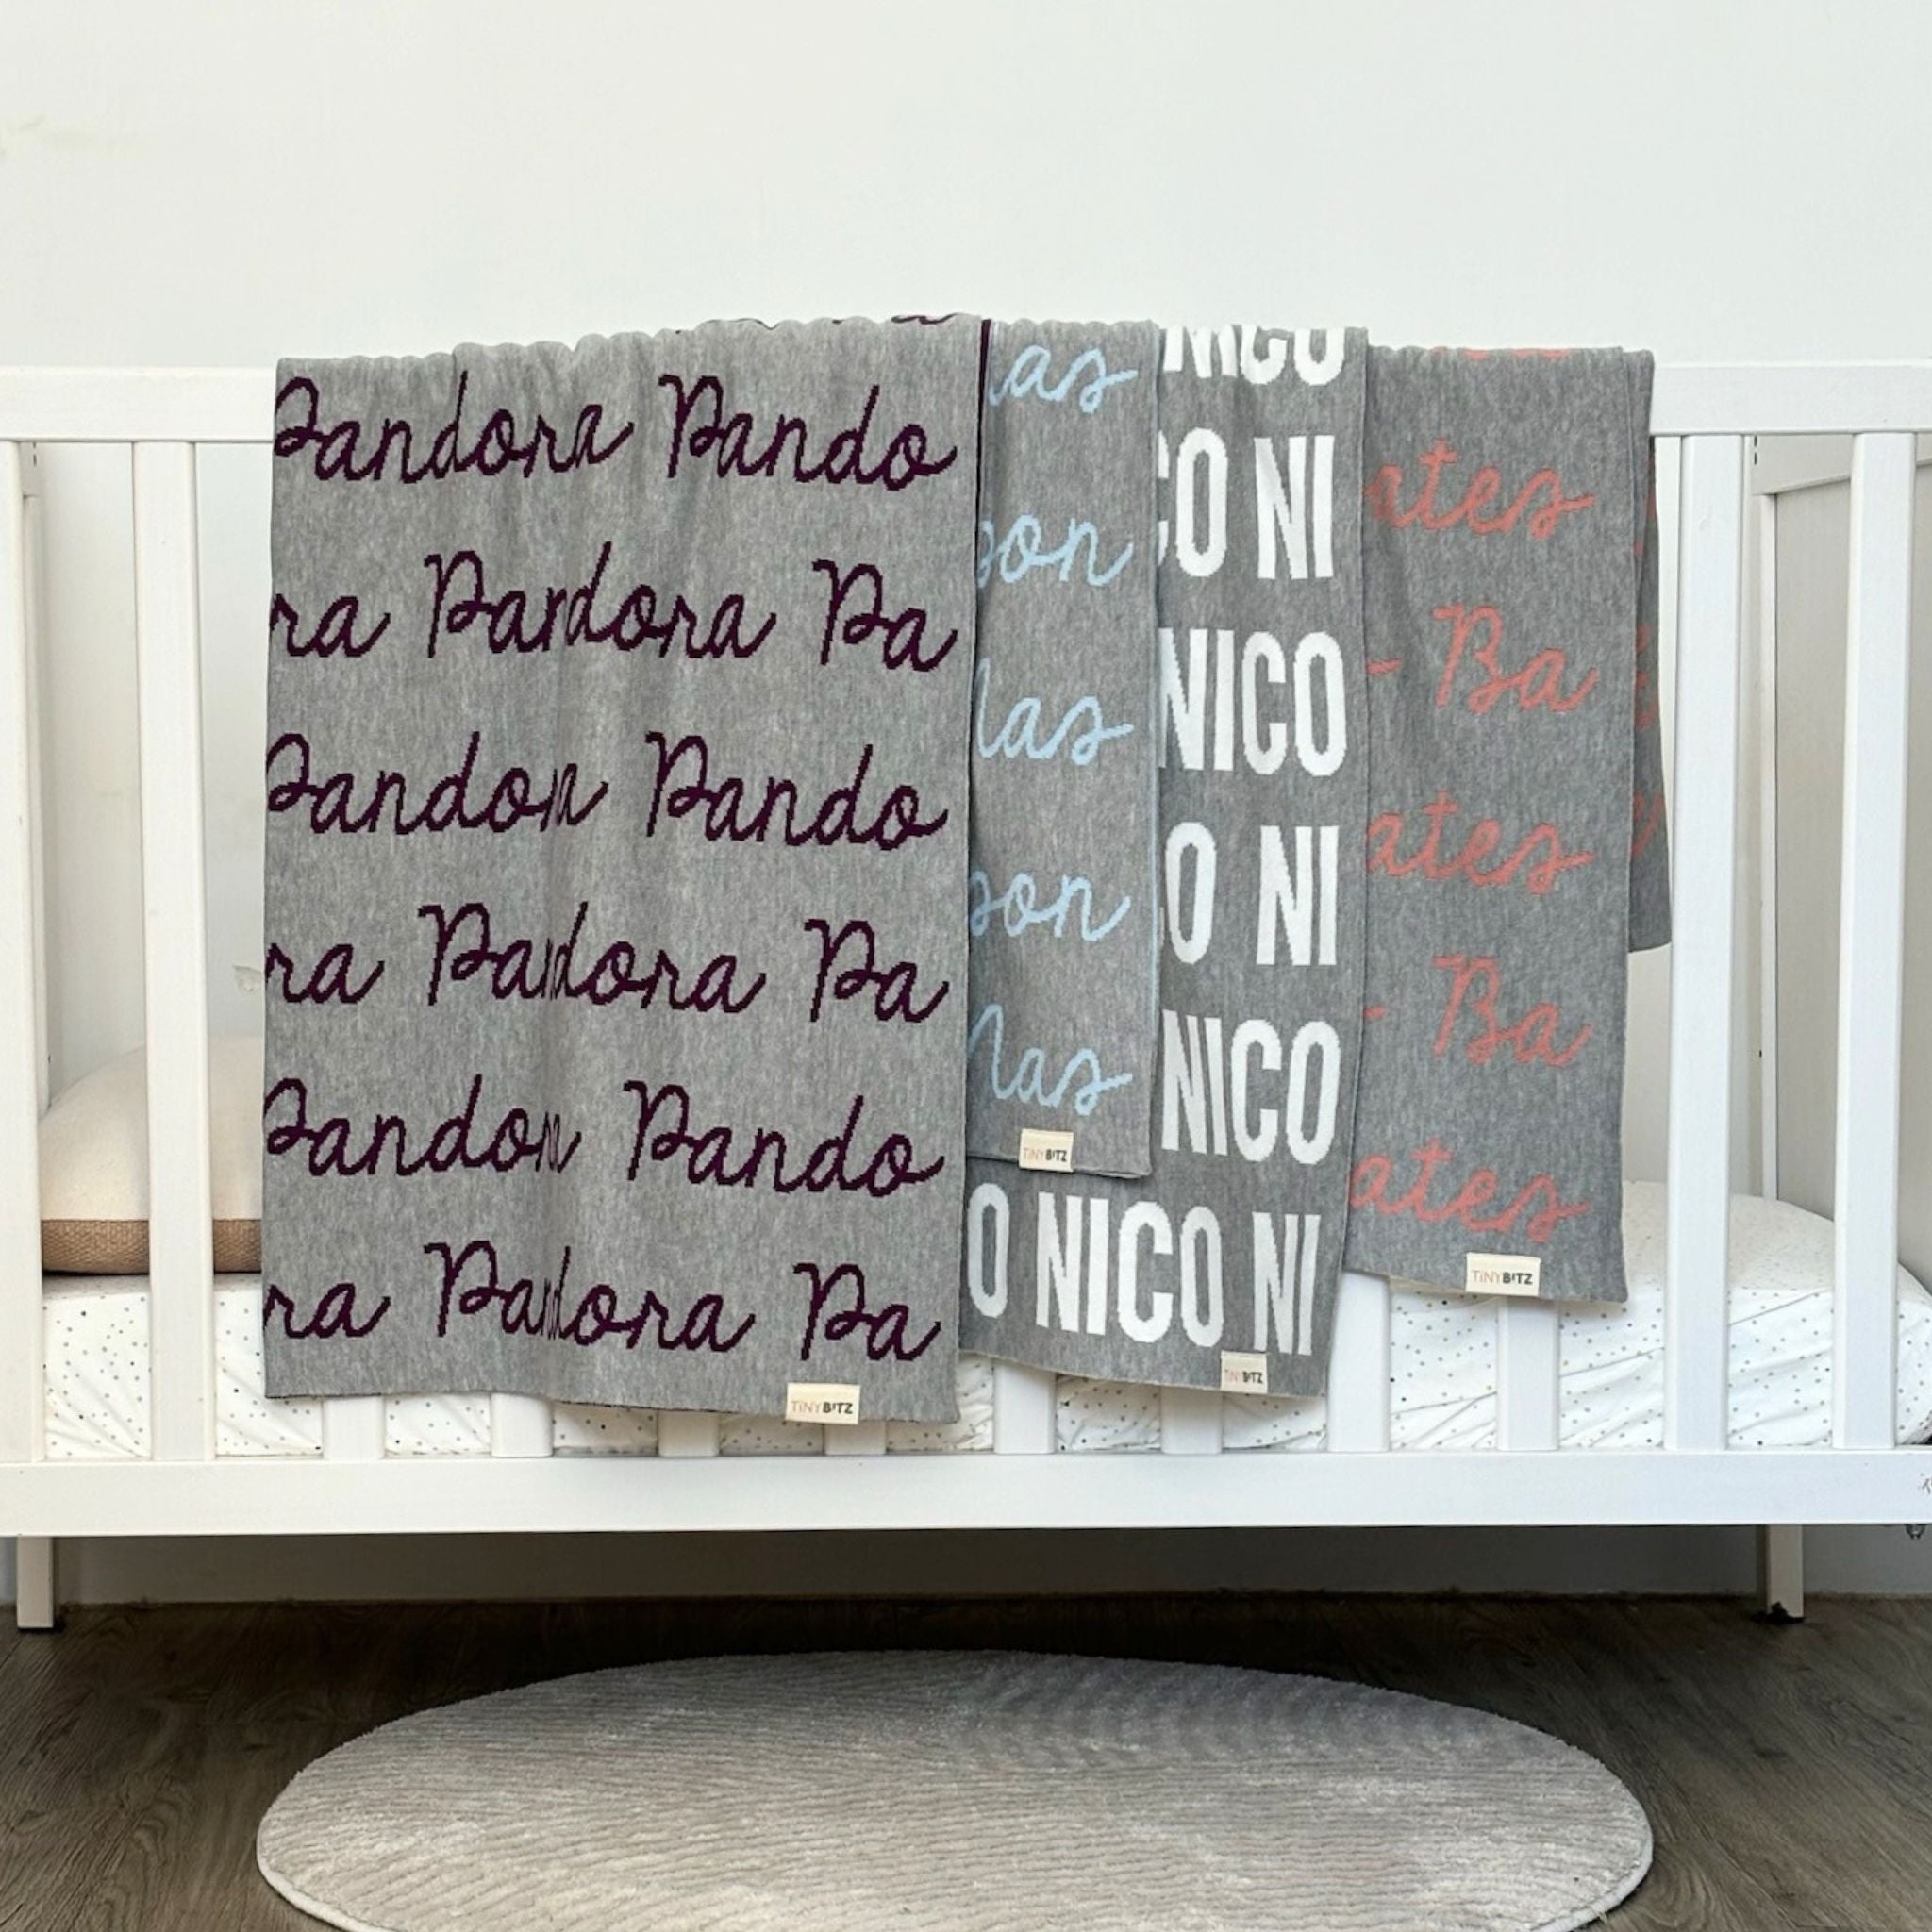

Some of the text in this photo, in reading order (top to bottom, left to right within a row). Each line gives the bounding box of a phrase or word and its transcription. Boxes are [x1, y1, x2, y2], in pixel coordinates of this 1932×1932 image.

[658, 375, 958, 491] Pando
[1254, 435, 1335, 580] NI
[425, 541, 776, 658] Pandora
[812, 558, 958, 672] Pa
[1432, 602, 1599, 714] Ba
[1159, 628, 1346, 776] NICO
[645, 731, 948, 850] Pando
[1257, 825, 1339, 966] NI
[805, 919, 949, 1023] Pa
[1433, 954, 1592, 1067] Ba
[624, 1080, 945, 1197] Pando
[1161, 1010, 1341, 1165] NICO
[793, 1263, 941, 1361] Pa
[1037, 1191, 1224, 1348] NICO
[1252, 1212, 1320, 1356] NI
